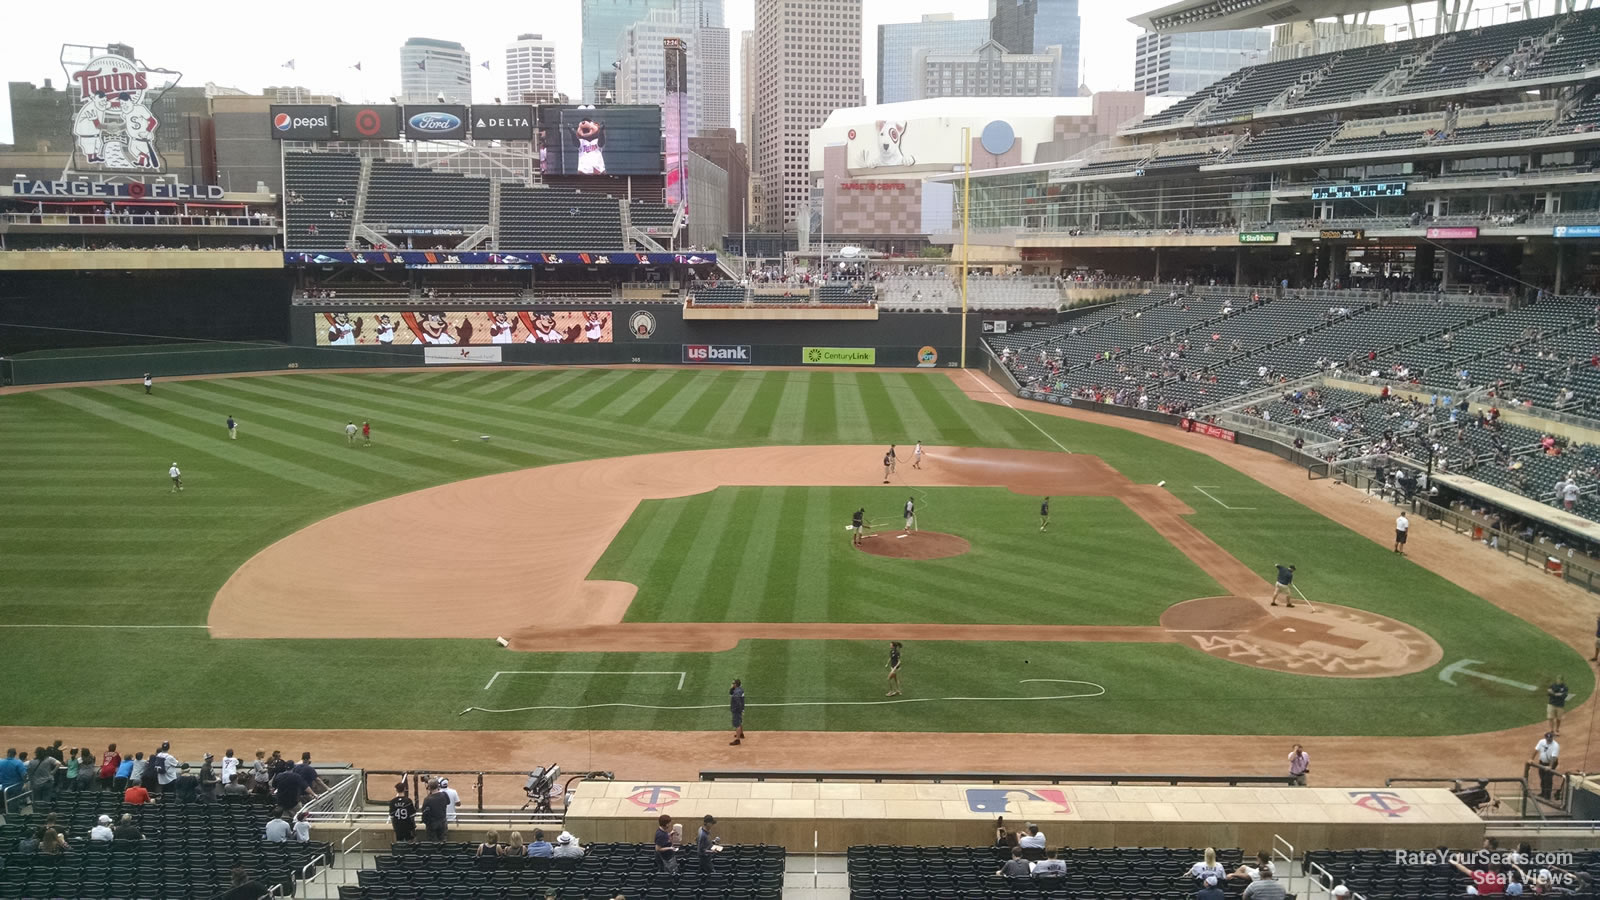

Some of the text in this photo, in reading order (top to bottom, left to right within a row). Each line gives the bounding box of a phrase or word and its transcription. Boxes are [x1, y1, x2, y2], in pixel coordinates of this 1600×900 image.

[73, 67, 148, 99] Twins
[293, 115, 328, 129] pepsi
[419, 113, 451, 130] Ford
[489, 118, 529, 127] DELTA
[14, 179, 225, 199] TARGET FIELD
[824, 351, 869, 361] CenturyLink
[394, 808, 408, 820] 49
